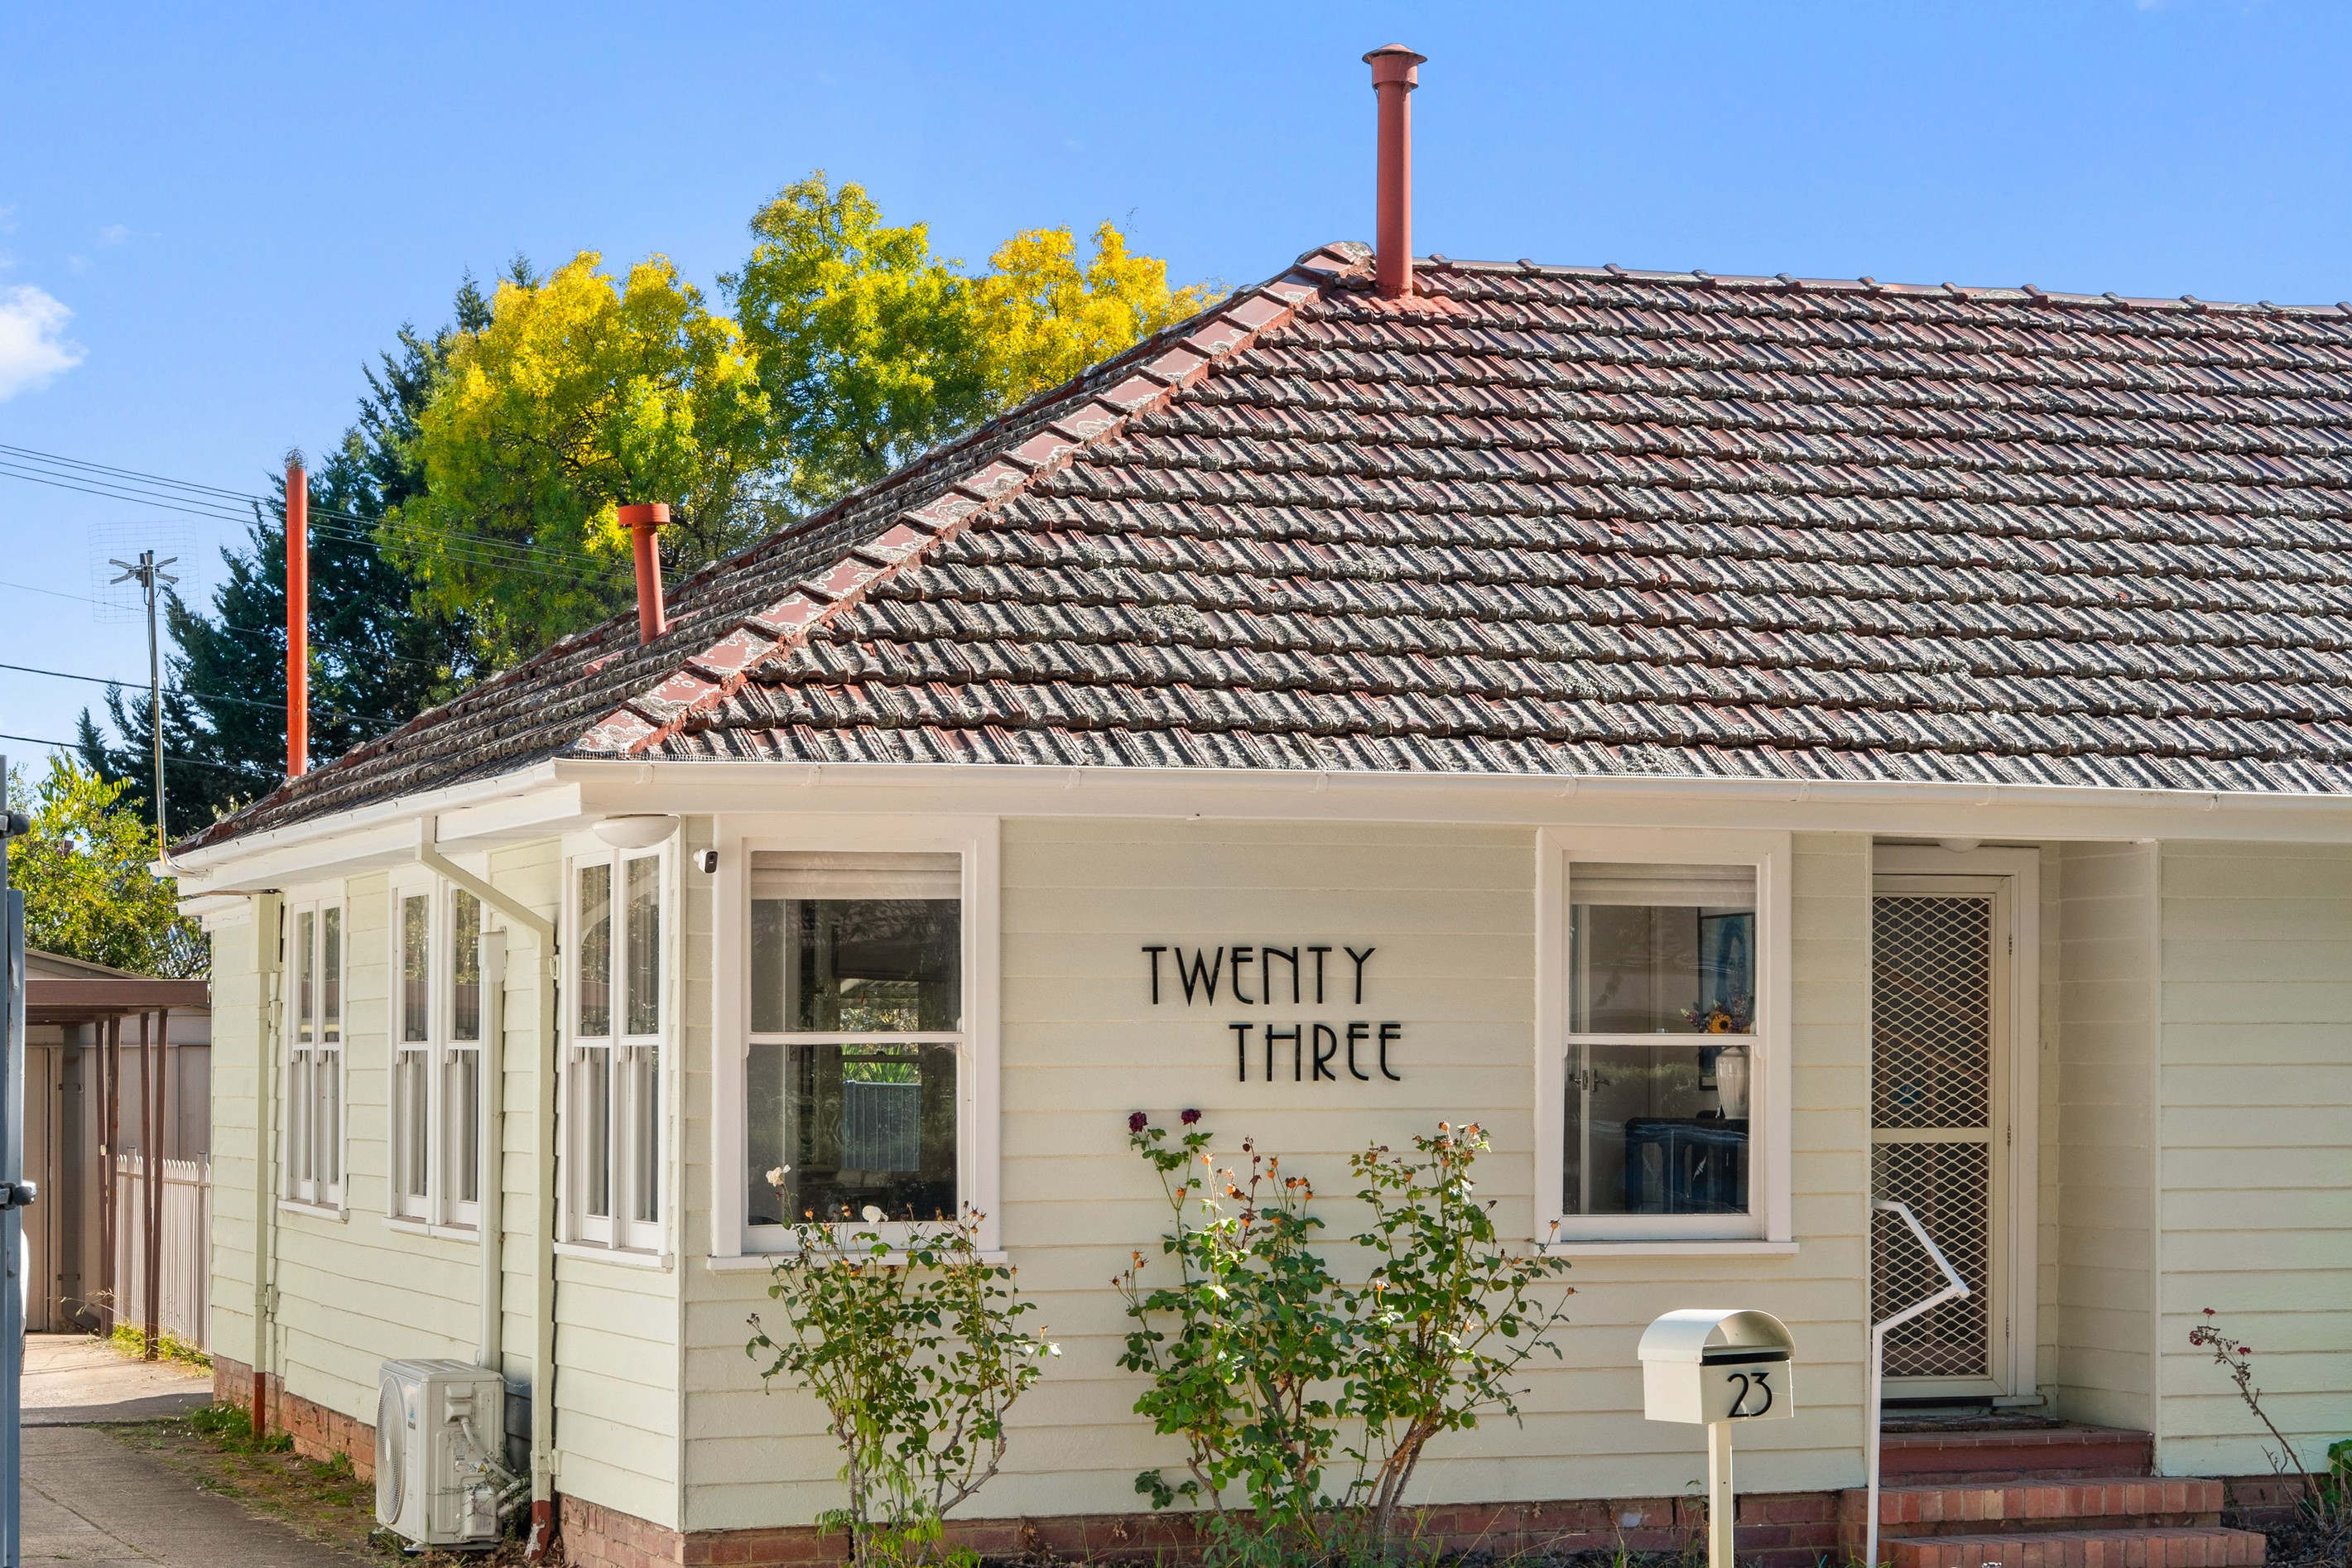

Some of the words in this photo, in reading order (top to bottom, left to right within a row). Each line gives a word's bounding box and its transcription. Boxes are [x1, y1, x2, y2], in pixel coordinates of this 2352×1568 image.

[1141, 945, 1377, 1008] TWENTY
[1228, 1022, 1402, 1083] THREE
[1726, 1372, 1773, 1418] 23
